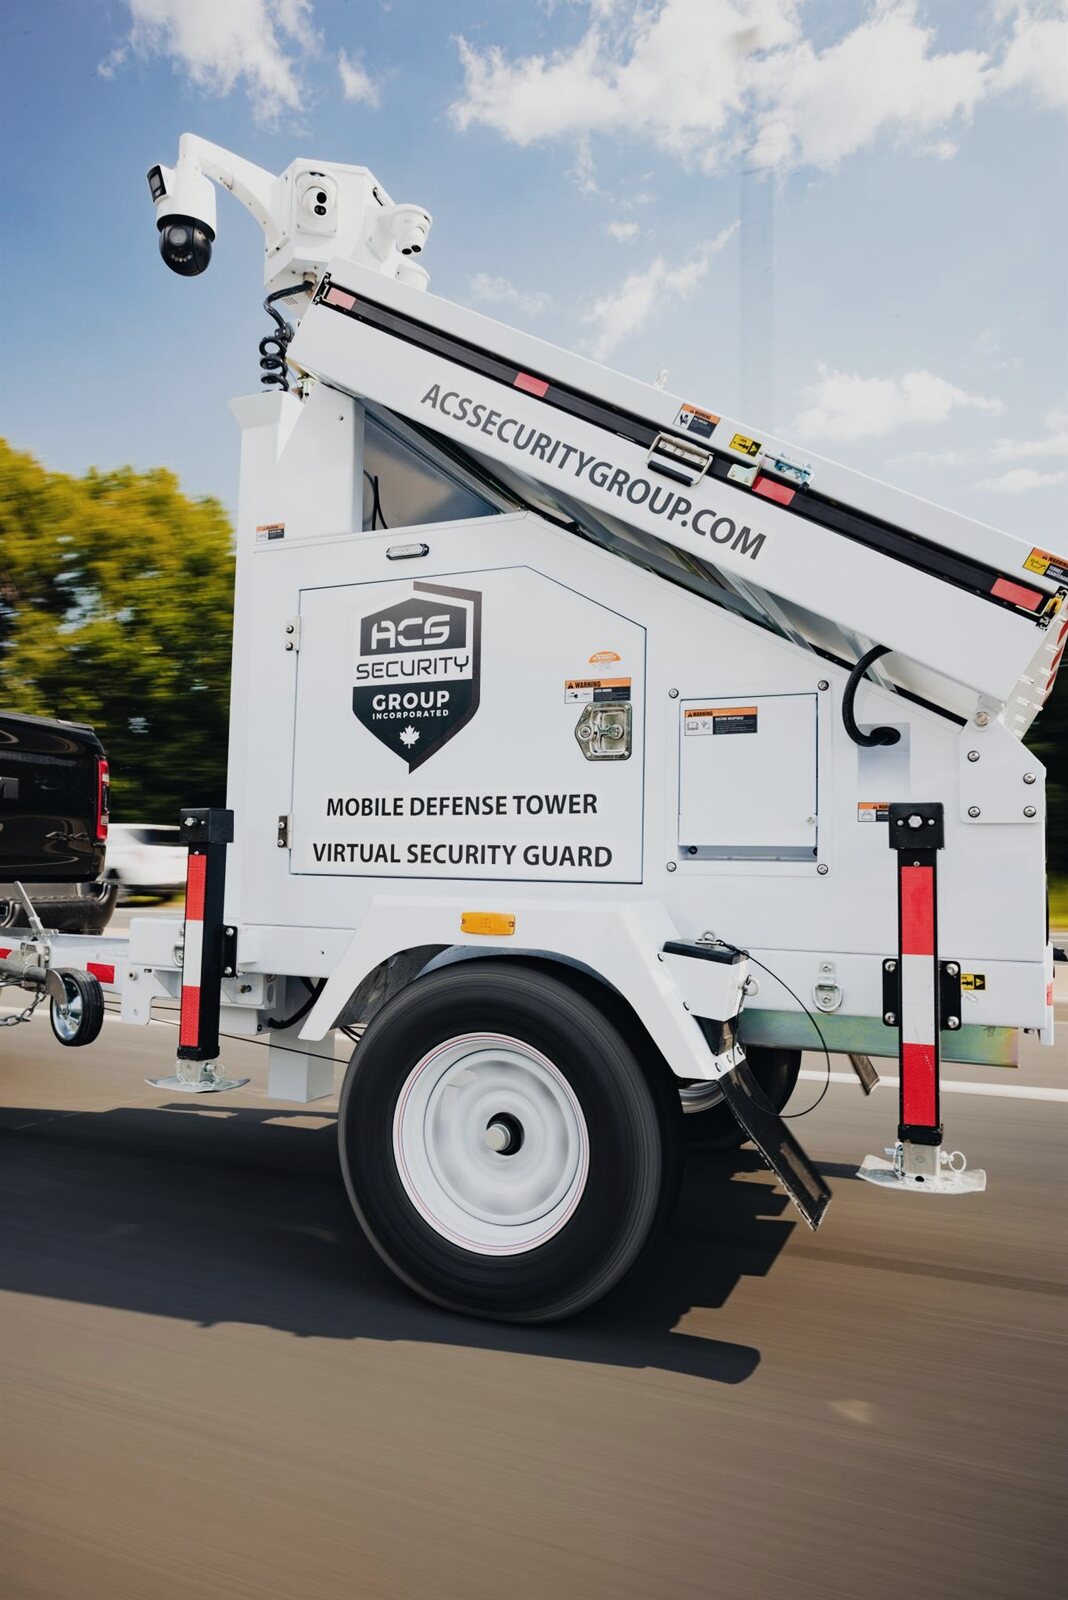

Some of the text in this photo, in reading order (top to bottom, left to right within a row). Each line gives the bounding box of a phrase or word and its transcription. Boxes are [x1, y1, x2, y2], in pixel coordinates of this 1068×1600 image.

[421, 384, 766, 560] ACSSECURITYGROUP.COM
[371, 614, 450, 650] ACS
[356, 655, 469, 680] SECURITY
[575, 680, 601, 688] WARNING
[372, 690, 450, 711] GROUP
[372, 709, 449, 720] INCORPORATED
[327, 793, 598, 816] MOBILE DEFENSE TOWER
[313, 843, 613, 868] VIRTUAL SECURITY GUARD
